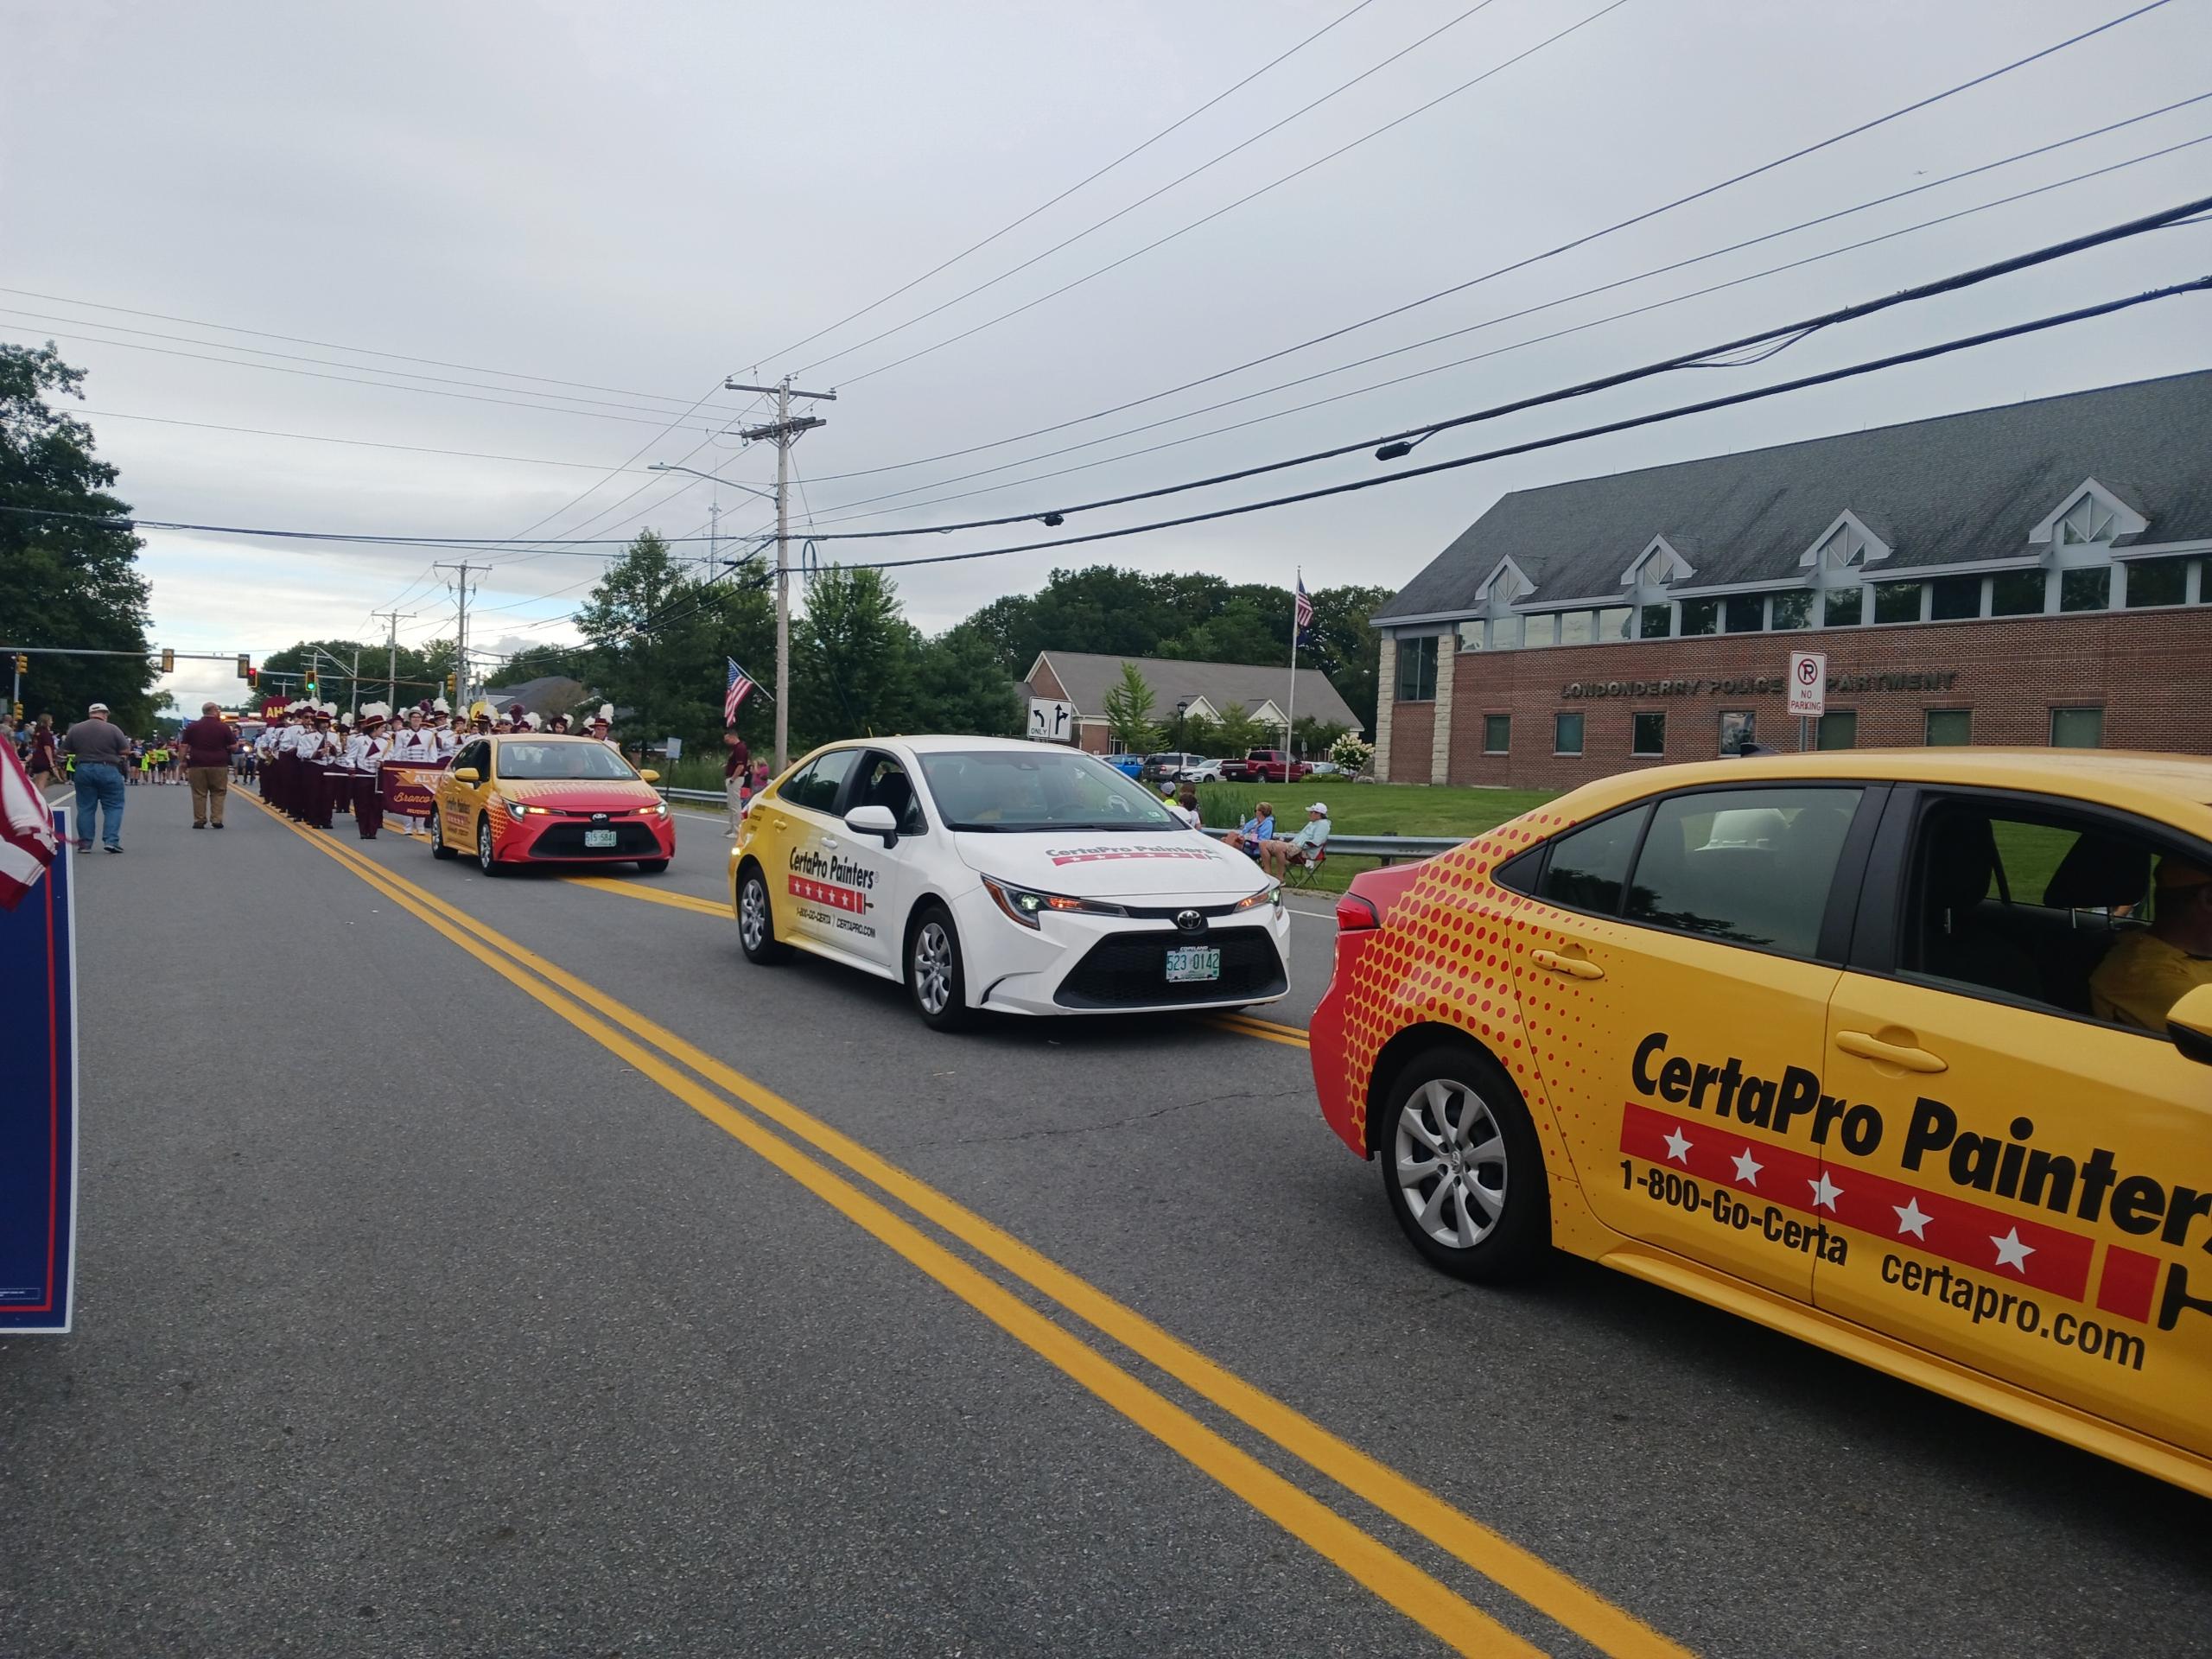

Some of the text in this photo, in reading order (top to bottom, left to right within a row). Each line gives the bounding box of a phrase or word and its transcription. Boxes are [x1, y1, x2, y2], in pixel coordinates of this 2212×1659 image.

[1561, 670, 1955, 698] LONDONDERRY POLICE PARTMENT
[1801, 690, 1812, 699] NO
[266, 707, 284, 718] AH
[1790, 700, 1821, 711] PARKING
[393, 792, 430, 803] Bronco
[1046, 846, 1131, 857] CertaPro
[790, 846, 874, 889] CertaPro Painters
[1166, 953, 1218, 970] 523 0142
[1631, 1032, 1883, 1156] CertaPro
[1620, 1160, 2145, 1371] 1-800-Go-Certa certapro.com
